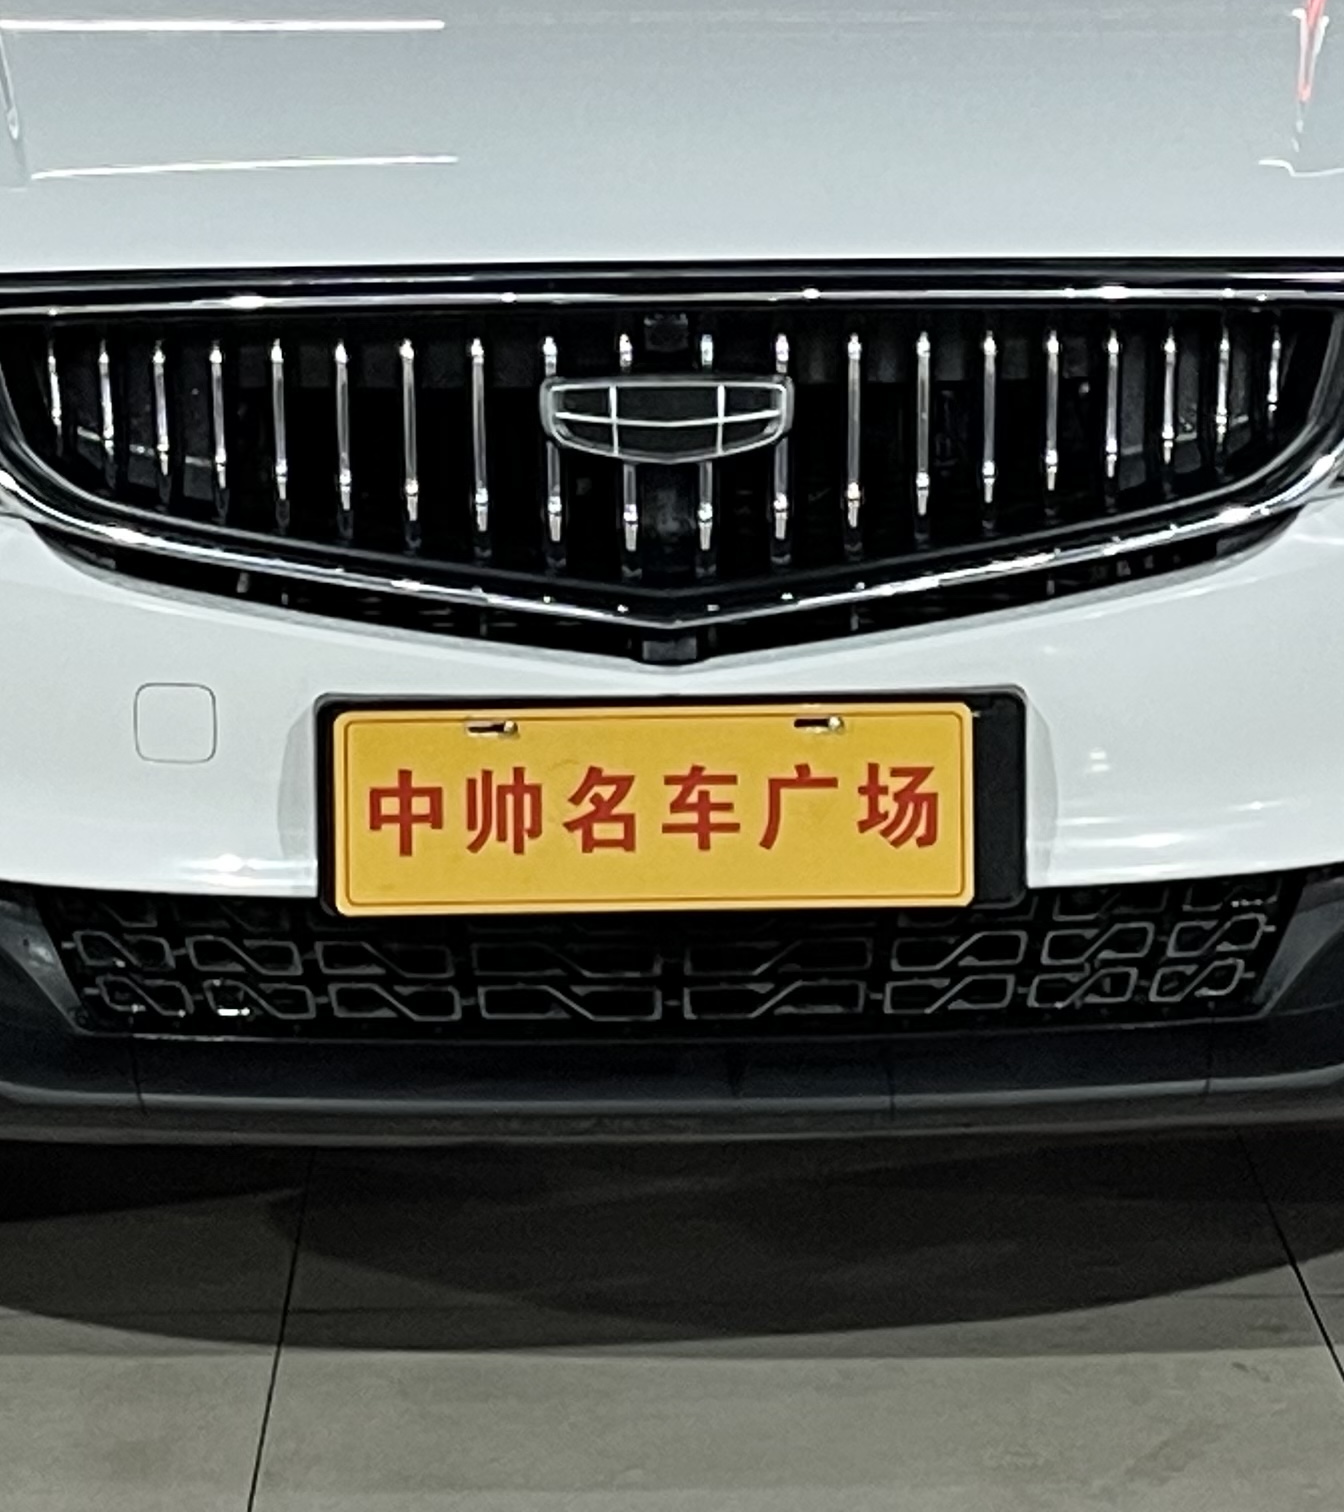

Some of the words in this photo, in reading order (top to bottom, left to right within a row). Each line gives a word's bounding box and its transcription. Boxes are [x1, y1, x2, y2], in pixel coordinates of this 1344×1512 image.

[367, 762, 940, 857] 中帅名车广场
